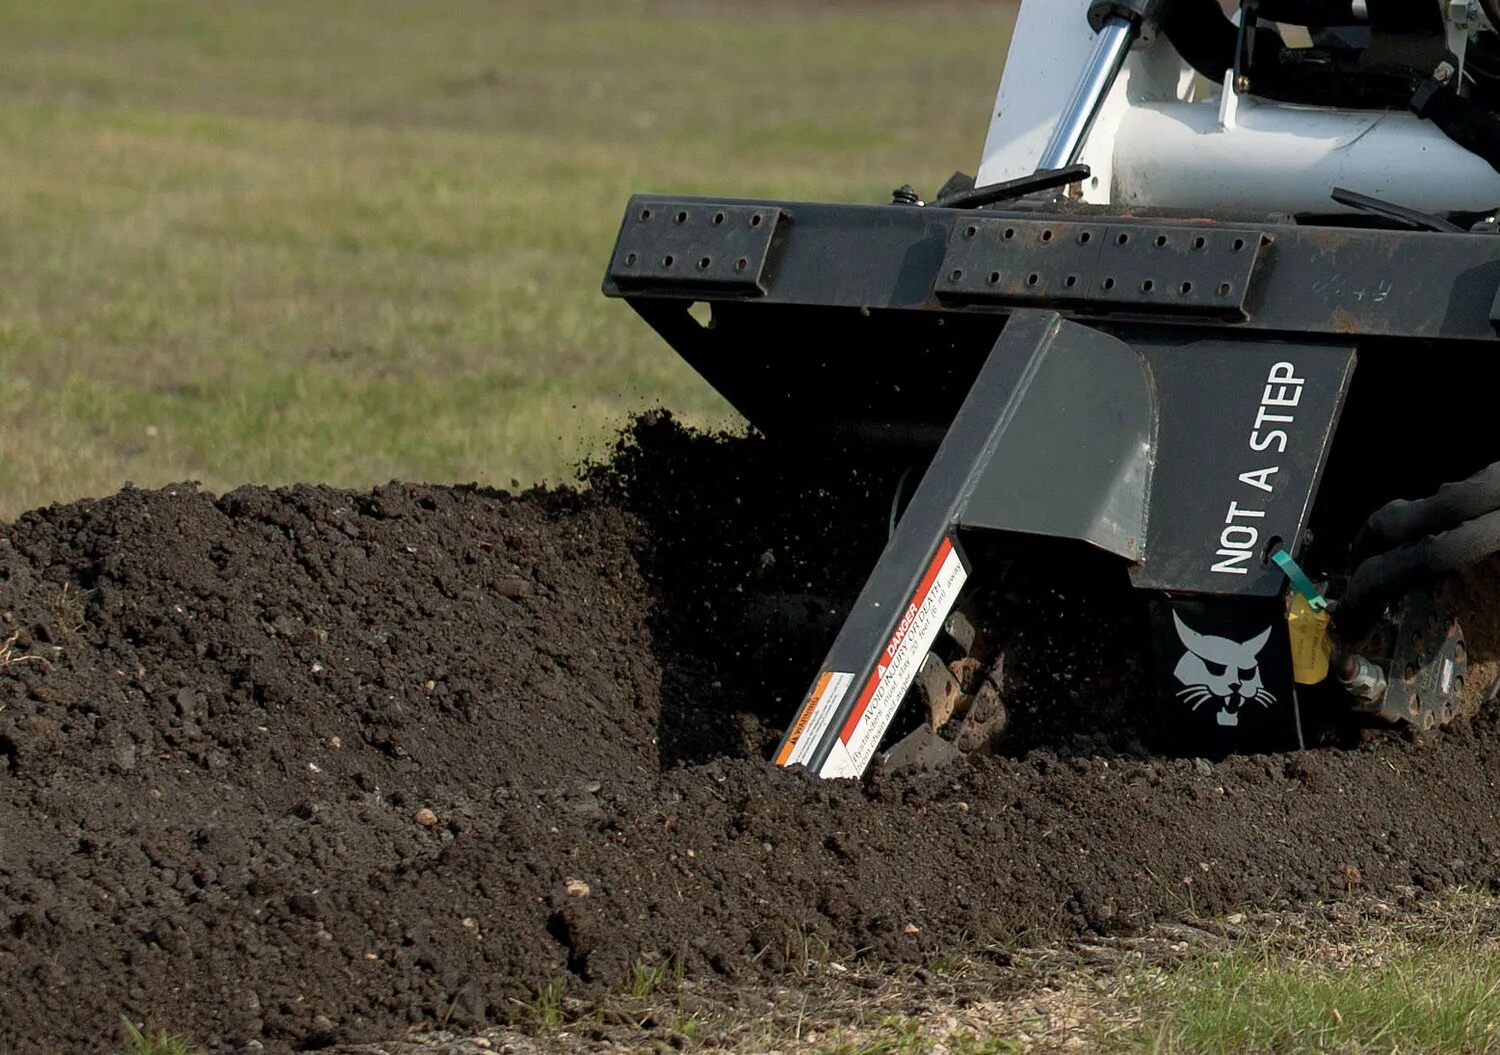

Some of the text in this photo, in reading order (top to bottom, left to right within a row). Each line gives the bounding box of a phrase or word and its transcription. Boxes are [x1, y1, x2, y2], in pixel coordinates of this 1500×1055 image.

[1210, 361, 1305, 574] NOT A STEP
[852, 709, 882, 762] Bystanders
[883, 680, 897, 707] must
[899, 656, 910, 677] stay
[910, 640, 919, 655] 20
[918, 618, 931, 639] feet
[946, 561, 962, 588] away
[864, 580, 941, 725] AVOID INJURY OR DEATH
[886, 602, 918, 658] DANGER
[857, 748, 871, 772] from
[869, 720, 885, 748] chain
[884, 700, 896, 720] and
